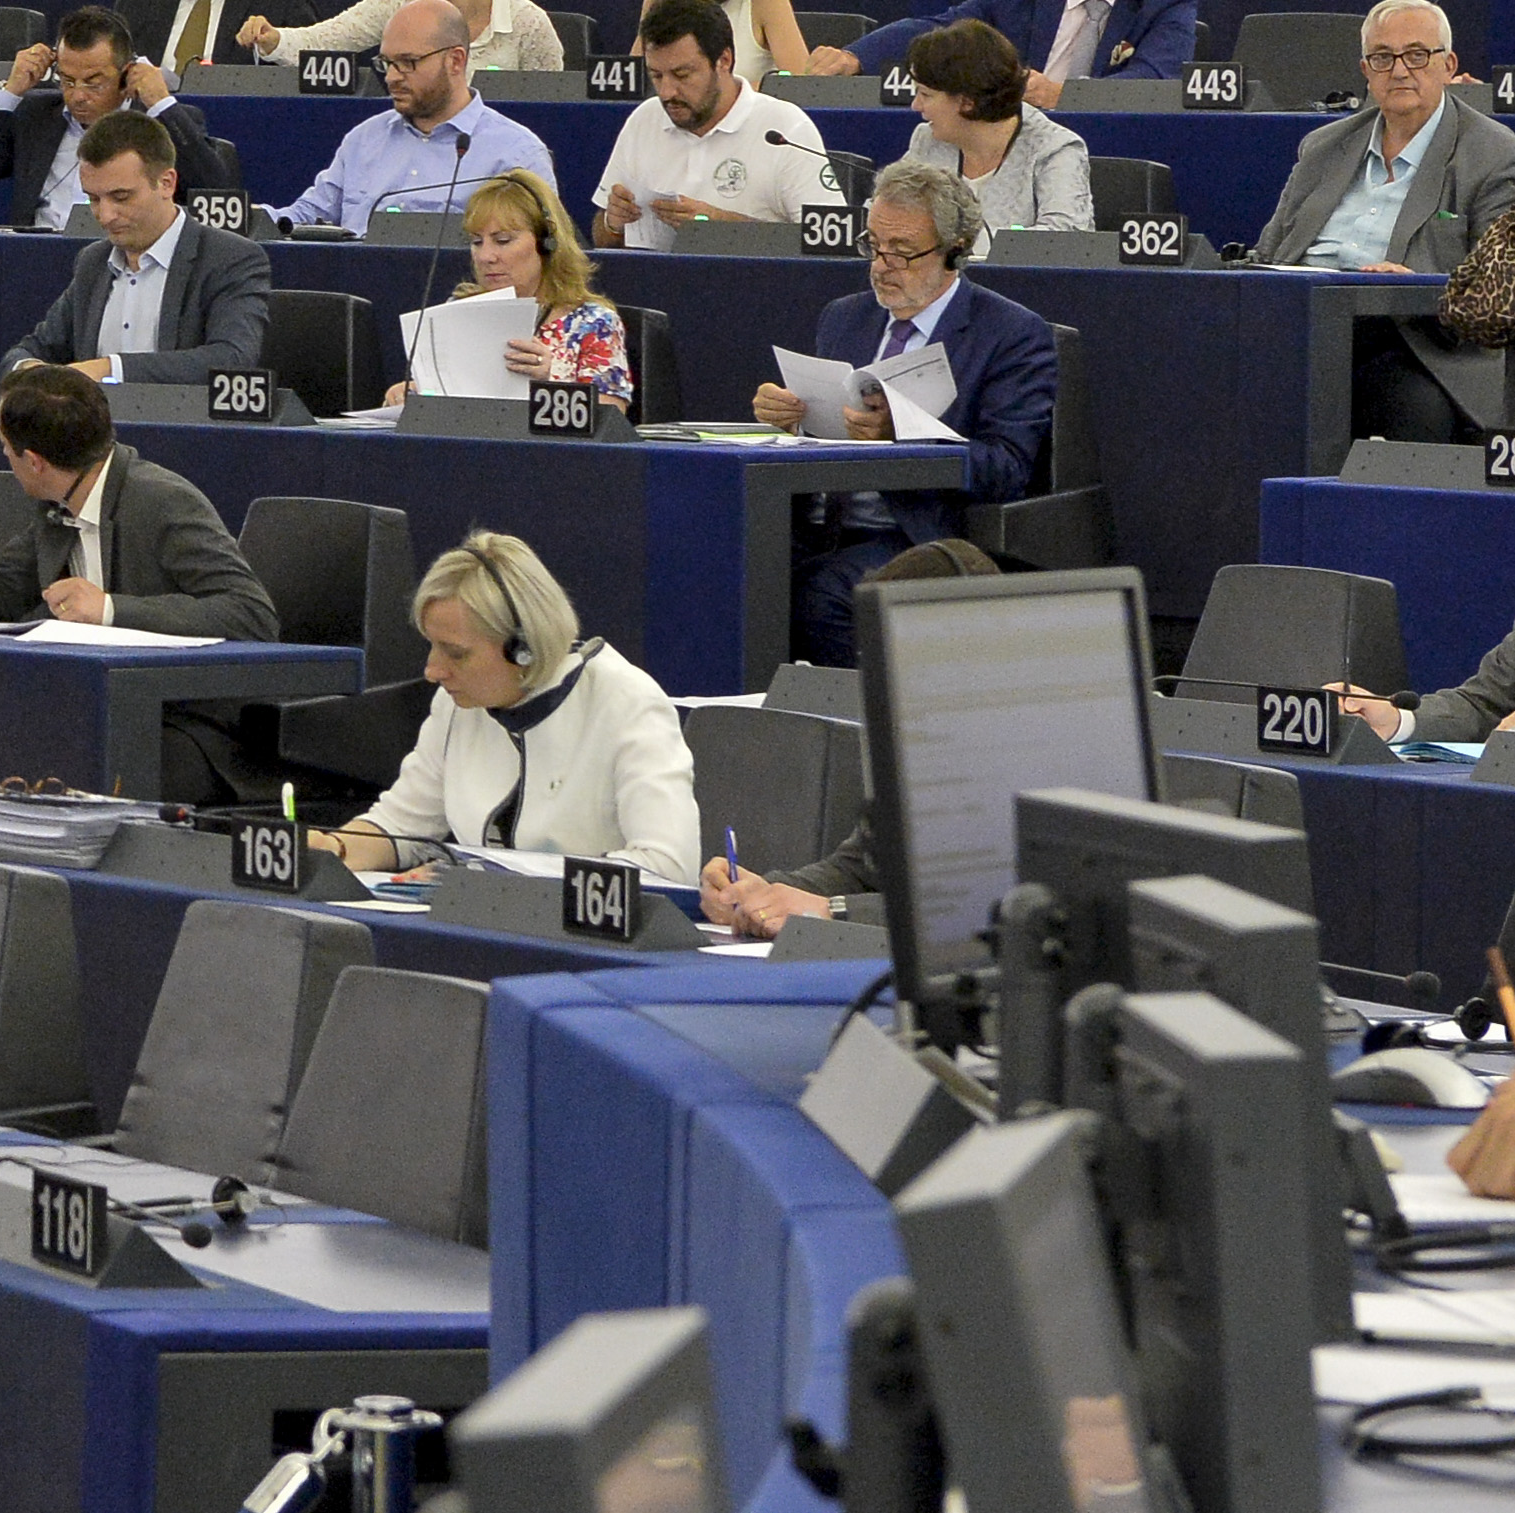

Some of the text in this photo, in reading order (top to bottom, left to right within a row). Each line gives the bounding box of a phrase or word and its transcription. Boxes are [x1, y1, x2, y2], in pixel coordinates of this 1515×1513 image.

[302, 56, 350, 87] 440
[591, 60, 637, 92] 441
[884, 70, 918, 96] 44
[1186, 70, 1238, 103] 443
[192, 194, 242, 229] 359
[804, 212, 852, 247] 361
[1120, 219, 1180, 256] 362
[213, 376, 266, 413] 285
[533, 387, 588, 428] 286
[1262, 693, 1323, 745] 220
[239, 824, 293, 881] 163
[570, 870, 623, 929] 164
[36, 1185, 87, 1261] 118
